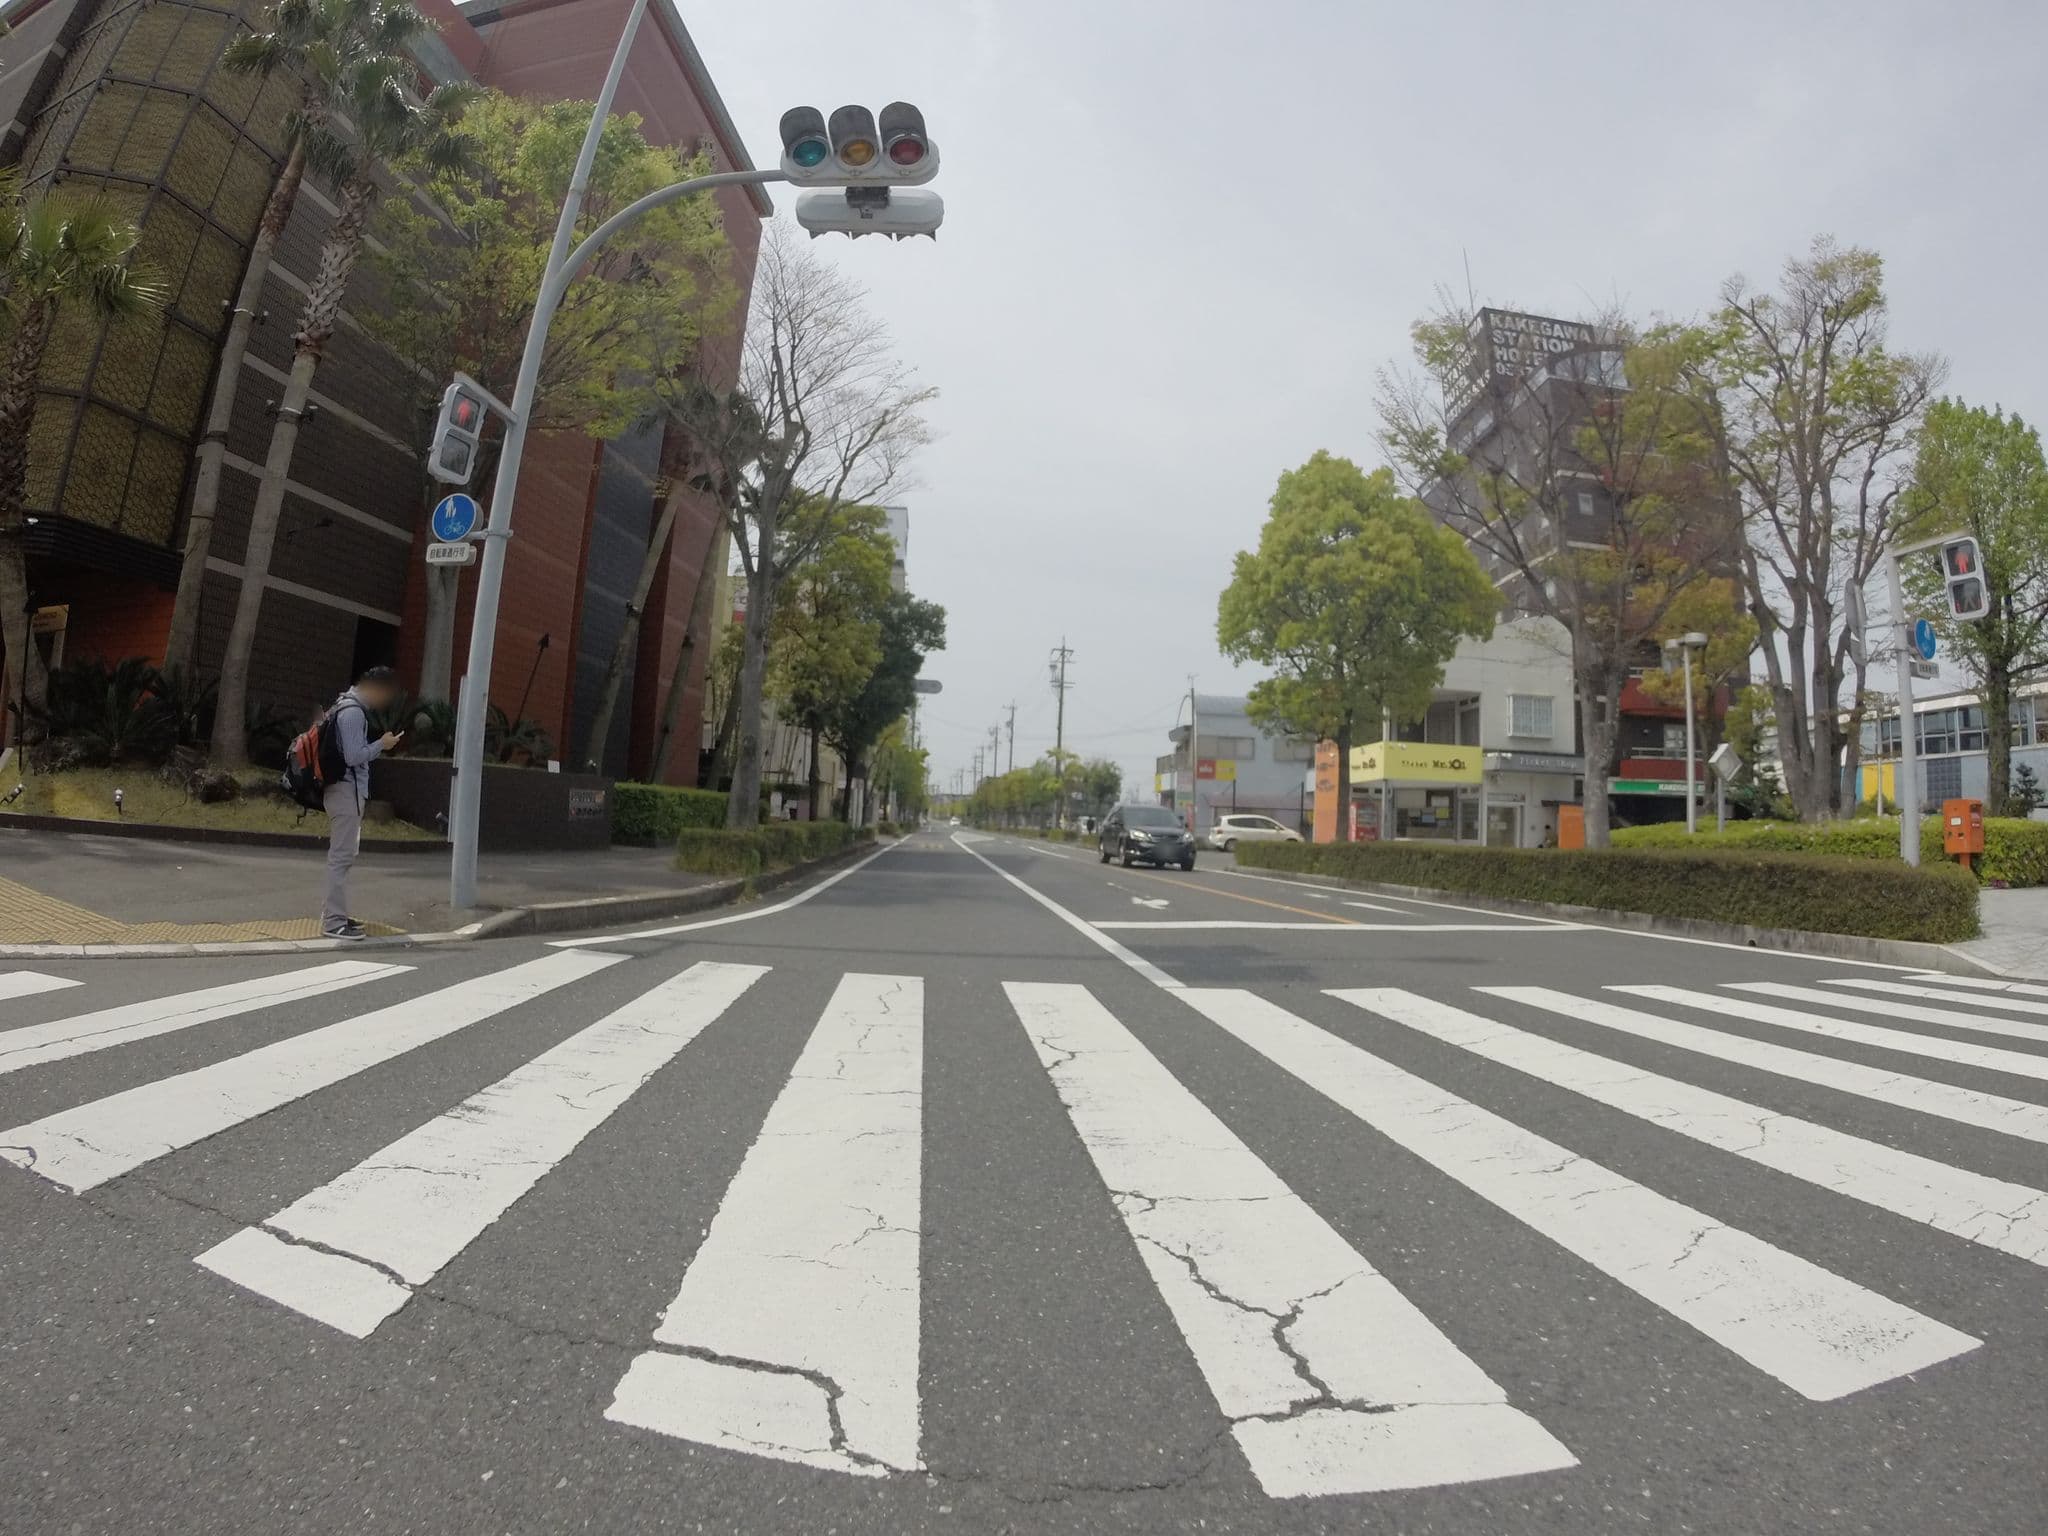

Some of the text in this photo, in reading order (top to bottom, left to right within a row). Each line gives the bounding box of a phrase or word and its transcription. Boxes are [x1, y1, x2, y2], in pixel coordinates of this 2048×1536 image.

[1489, 312, 1592, 343] KAKEGAWA
[430, 547, 466, 559] 自転車通行可
